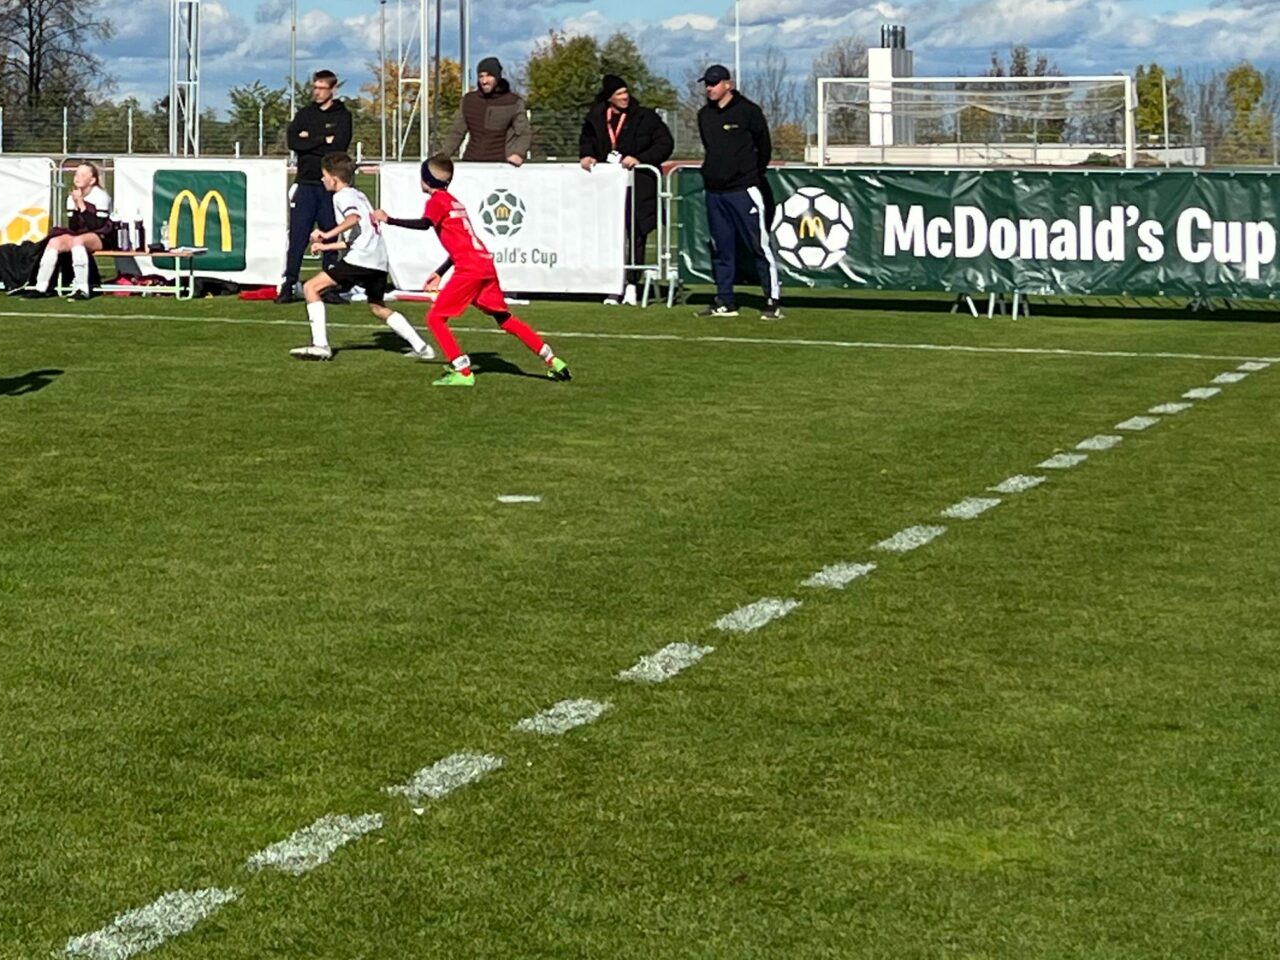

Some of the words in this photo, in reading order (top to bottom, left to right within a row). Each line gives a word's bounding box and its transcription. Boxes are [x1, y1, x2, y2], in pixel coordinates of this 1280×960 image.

[531, 247, 558, 269] Cup
[883, 204, 1165, 263] McDonald's
[1176, 207, 1277, 279] Cup
